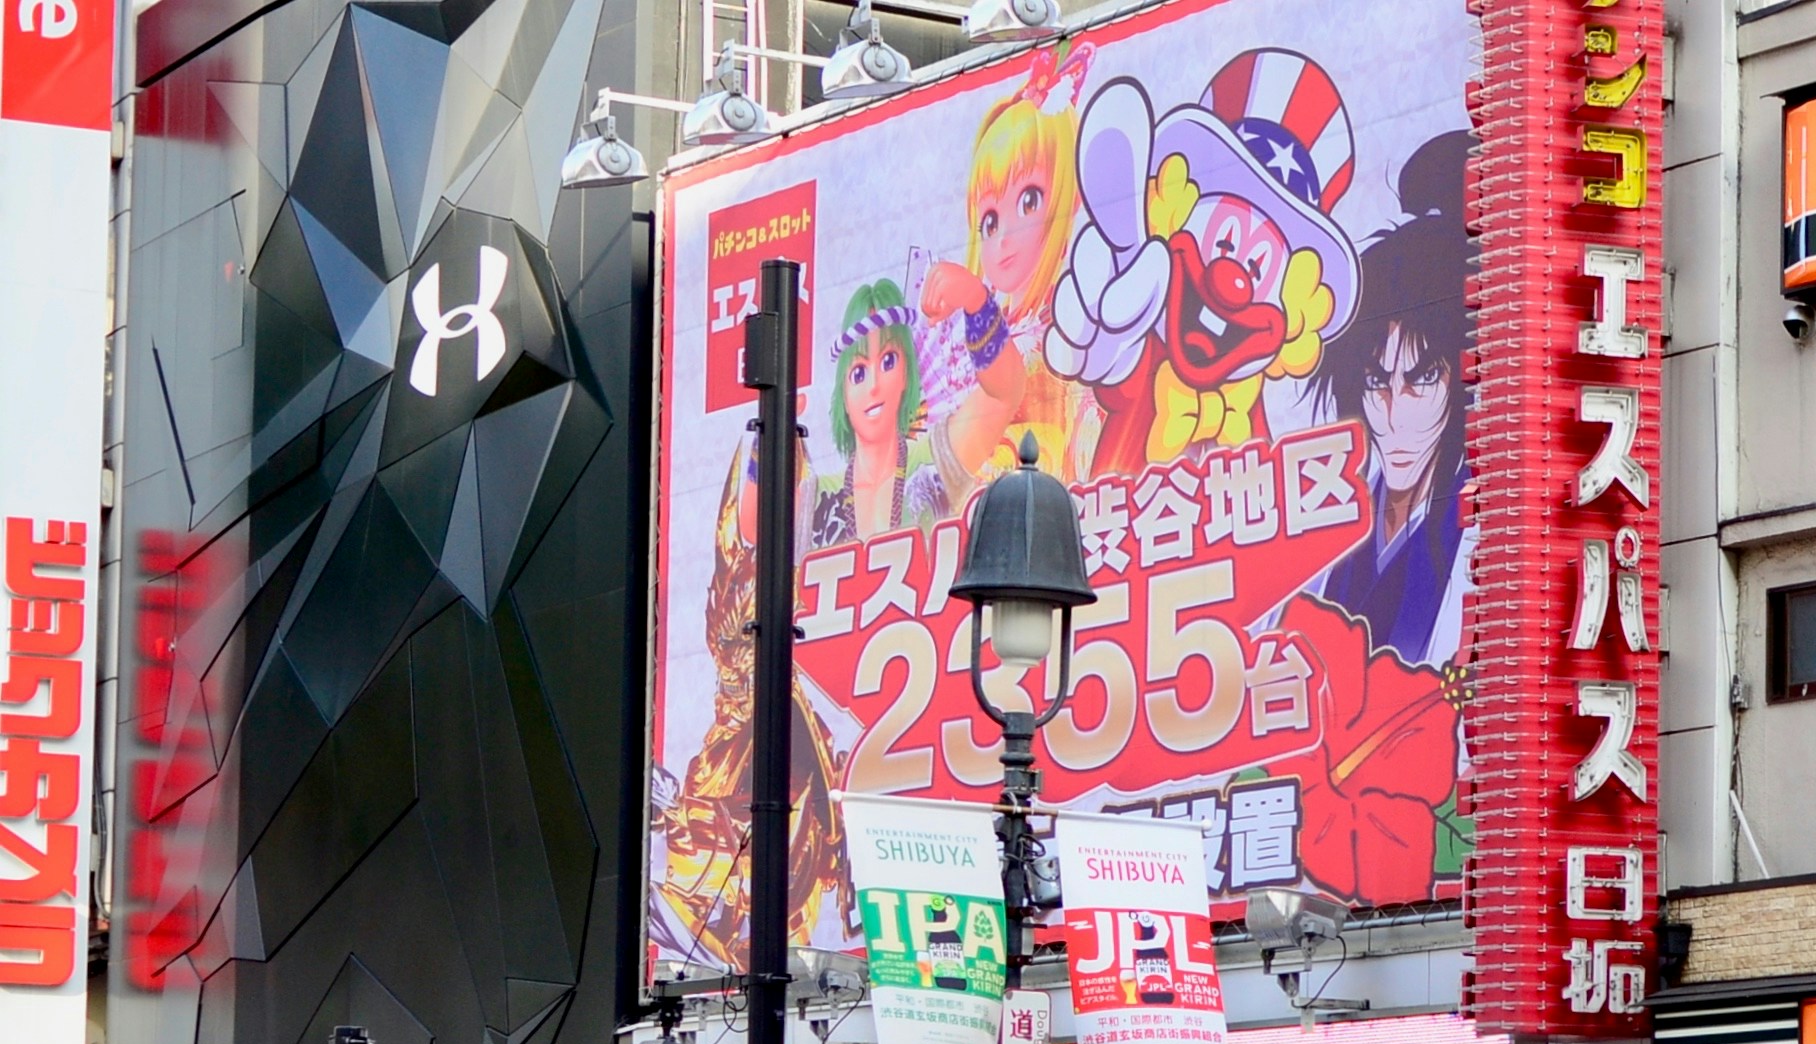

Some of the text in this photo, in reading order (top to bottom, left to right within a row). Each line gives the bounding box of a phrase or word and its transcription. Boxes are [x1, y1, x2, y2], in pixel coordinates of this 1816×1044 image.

[875, 838, 976, 868] SHIBUYA
[1086, 857, 1185, 885] SHIBUYA
[867, 890, 1006, 964] IPA
[1076, 910, 1215, 976] JPL
[974, 959, 999, 973] NEW
[966, 967, 1005, 987] GRAND
[1183, 974, 1208, 985] NEW
[1173, 982, 1219, 998] GRAND
[1180, 993, 1218, 1007] KIRIN
